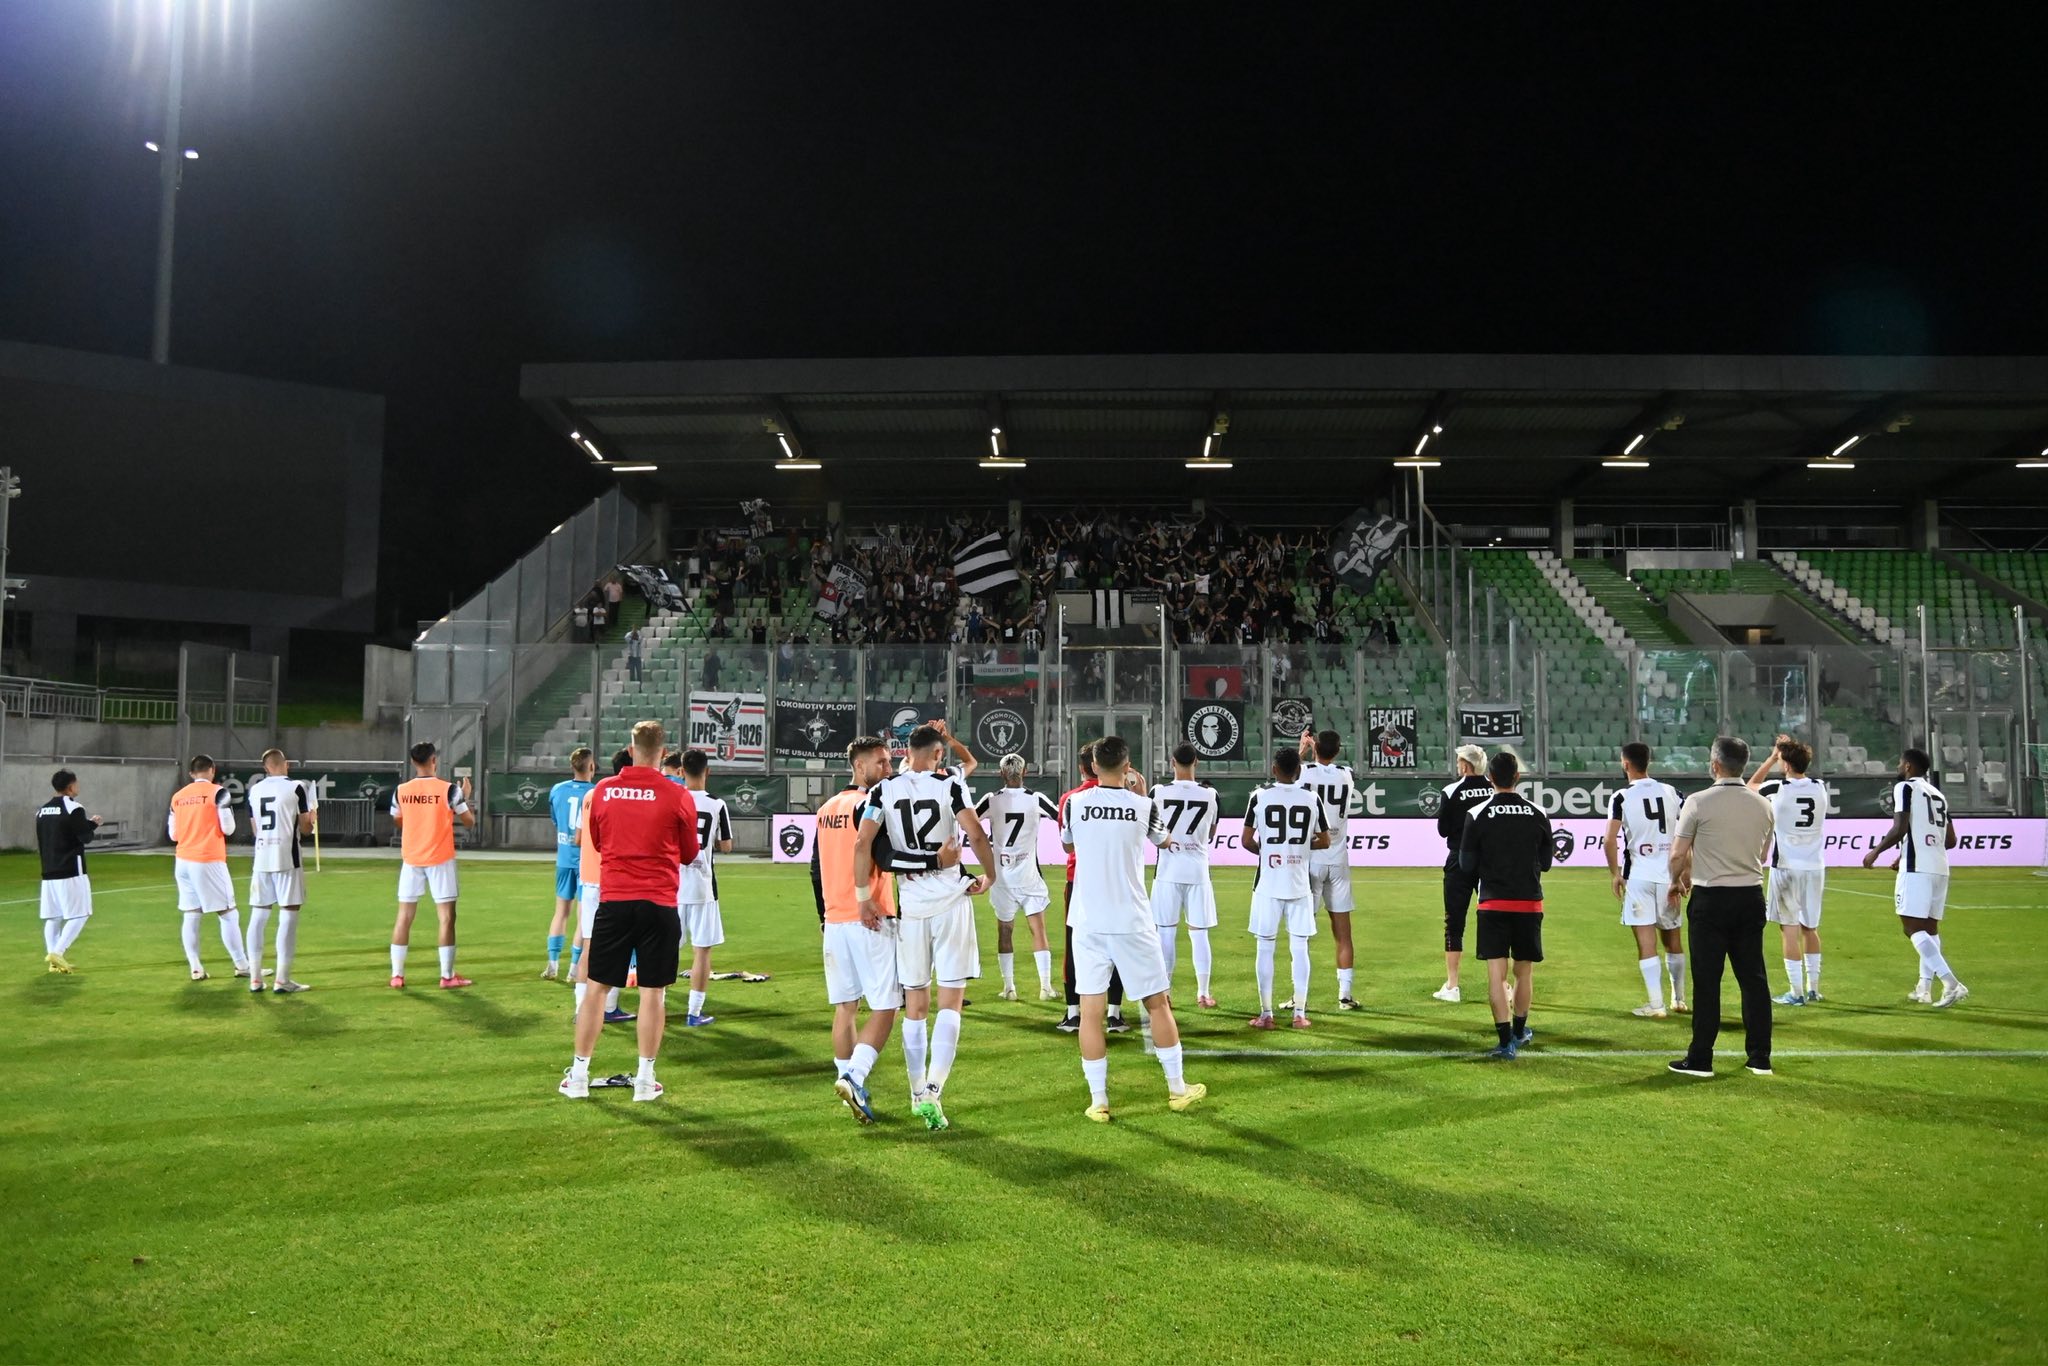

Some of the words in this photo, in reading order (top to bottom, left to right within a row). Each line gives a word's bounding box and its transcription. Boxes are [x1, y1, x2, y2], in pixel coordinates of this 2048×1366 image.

[776, 700, 825, 711] LOKOMOTIV
[826, 703, 857, 711] PLOVDI
[692, 722, 717, 744] LPFC
[738, 724, 762, 746] 1926
[791, 749, 816, 758] USUAL
[818, 751, 848, 759] SUSPEC
[260, 796, 276, 831] 5
[402, 795, 440, 804] WINBET
[1163, 799, 1209, 835] 77
[1642, 796, 1666, 834] 4
[1795, 797, 1816, 828] 3
[1923, 792, 1946, 828] 13
[893, 798, 943, 852] 12
[1005, 812, 1025, 847] 7
[1264, 804, 1311, 845] 99
[1824, 835, 1862, 850] PFC
